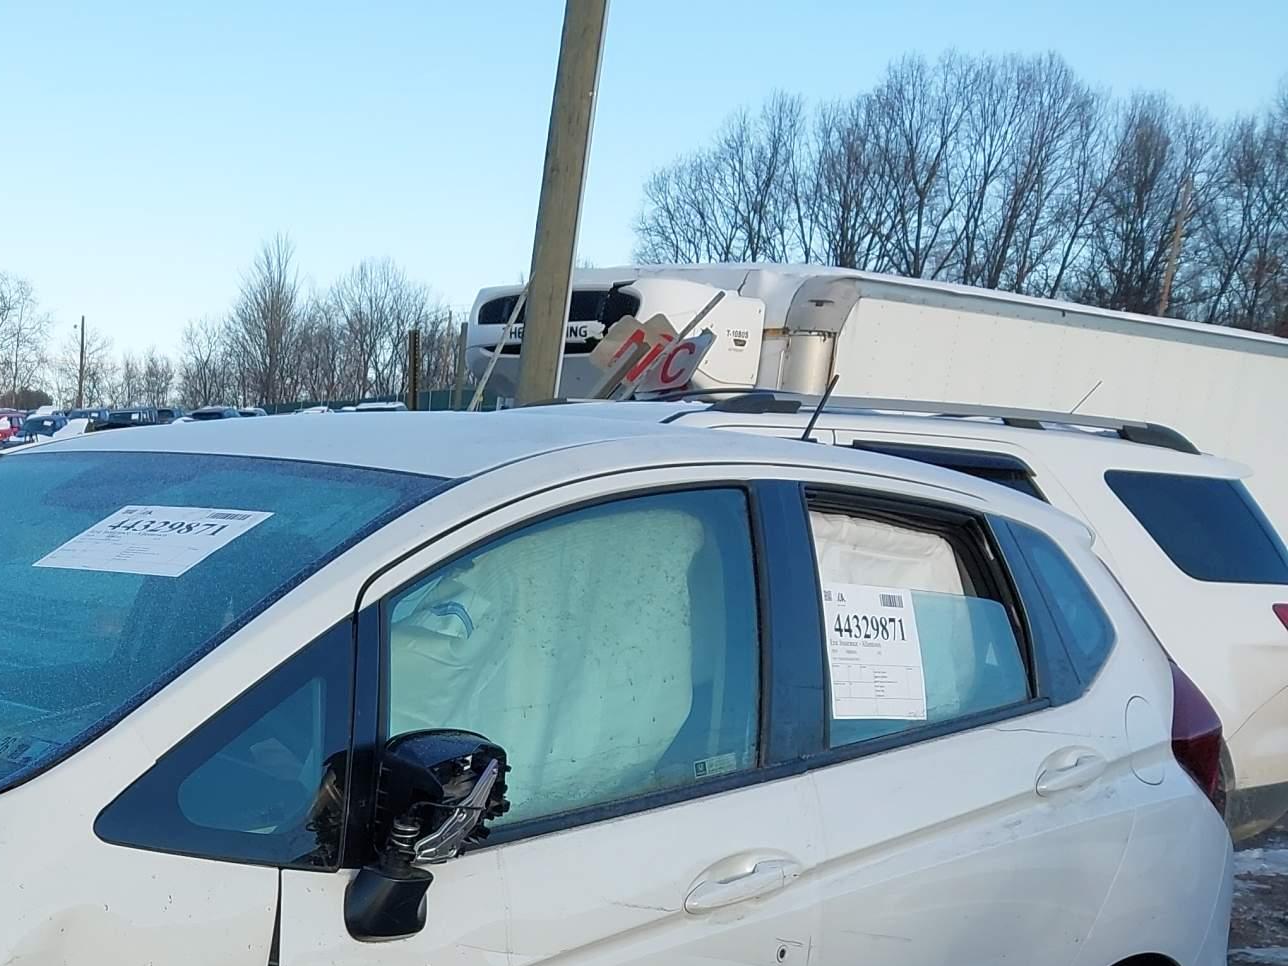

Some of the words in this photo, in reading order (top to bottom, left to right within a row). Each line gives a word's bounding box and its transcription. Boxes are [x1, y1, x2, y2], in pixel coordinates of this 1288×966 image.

[661, 342, 696, 384] C
[108, 519, 228, 536] 44329871
[834, 614, 906, 641] 44329871
